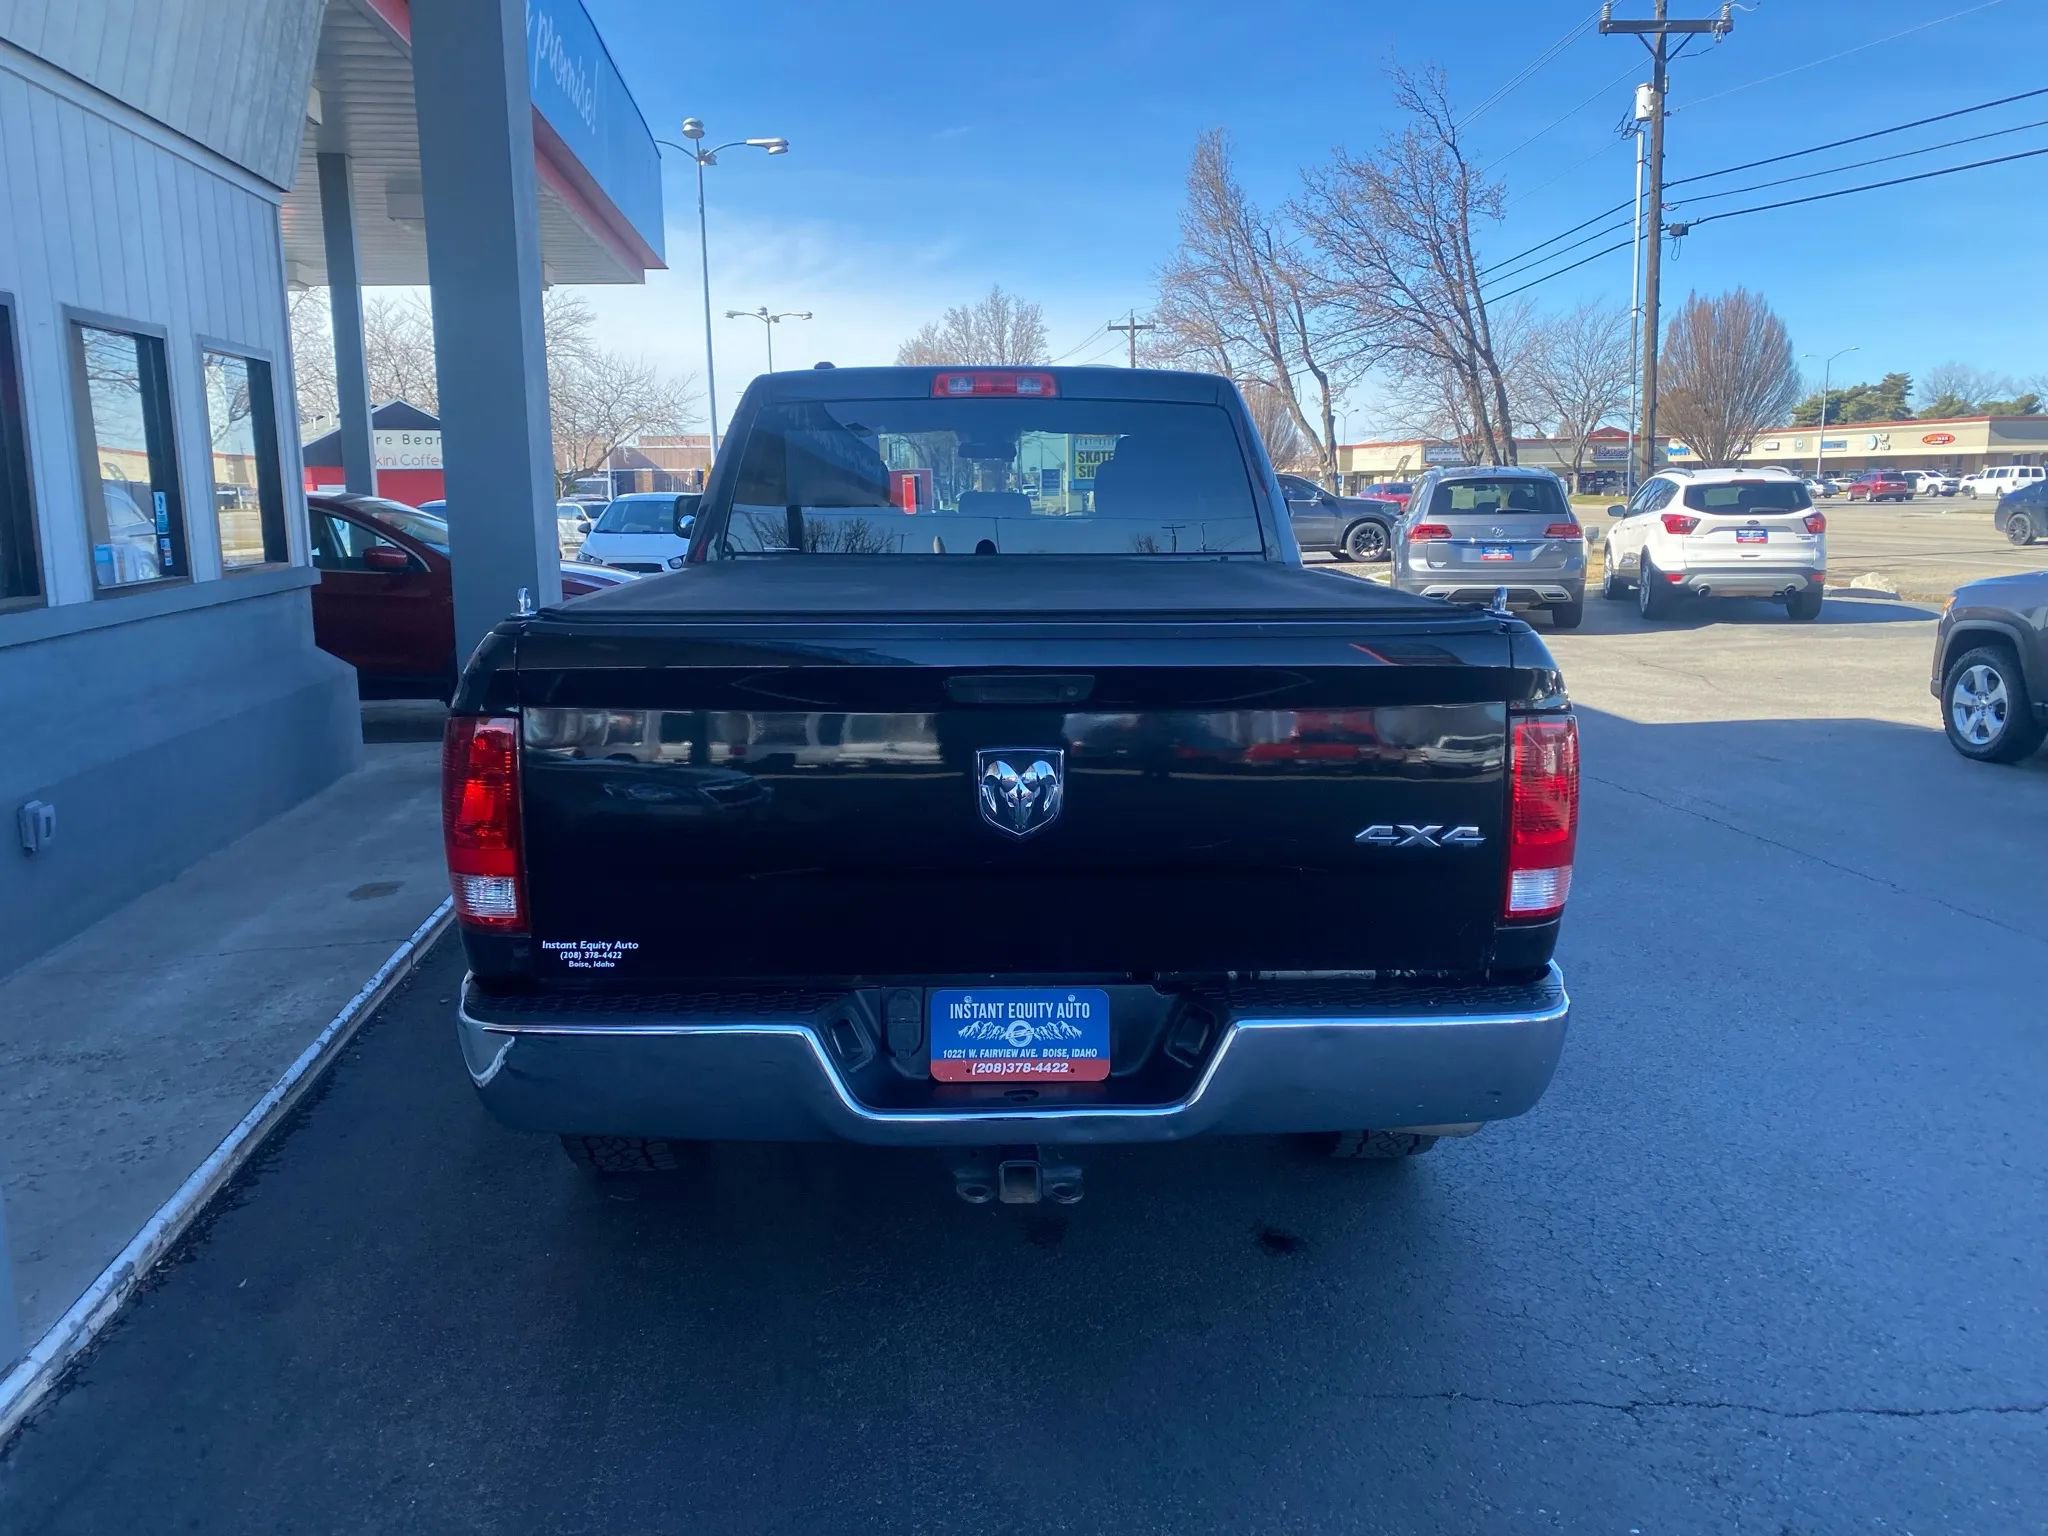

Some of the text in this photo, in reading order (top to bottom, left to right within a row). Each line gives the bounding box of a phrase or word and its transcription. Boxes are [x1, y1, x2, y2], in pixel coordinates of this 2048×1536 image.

[534, 8, 599, 136] promise!
[400, 454, 441, 466] Coffe
[542, 940, 639, 951] Instant Equity Auto
[560, 951, 622, 960] (208) 378-4422
[568, 960, 615, 968] Boise, Idaho
[949, 1002, 1090, 1020] INSTANT EQUITY AUTO
[943, 1048, 1098, 1059] 10221 W. FAIRVIEW AVE. BOISE, IDAHO
[971, 1062, 1069, 1075] (208)378-4422
